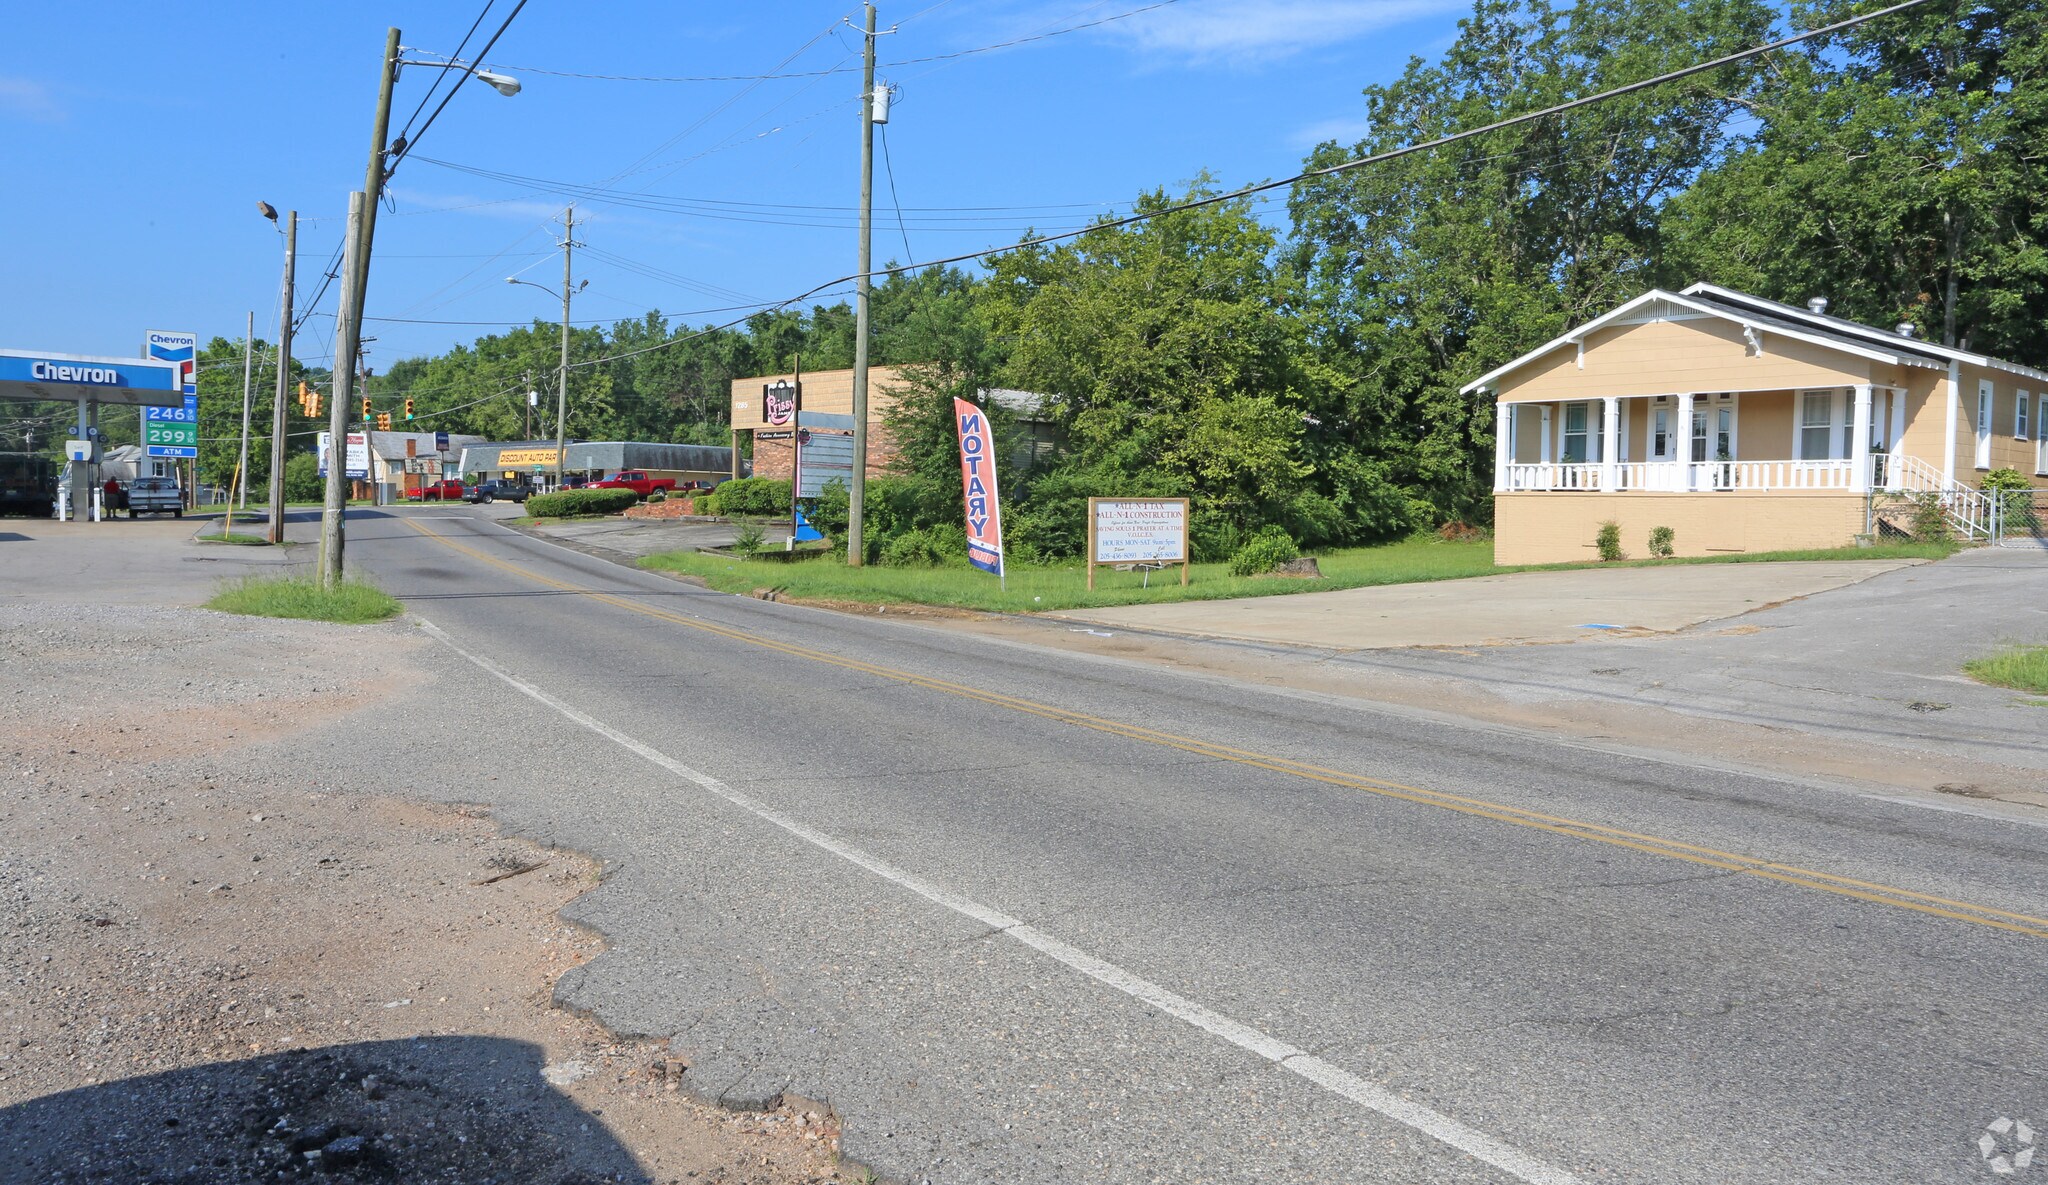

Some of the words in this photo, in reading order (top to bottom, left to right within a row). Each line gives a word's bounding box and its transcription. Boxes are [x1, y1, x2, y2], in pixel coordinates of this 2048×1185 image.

[150, 334, 194, 345] Chevron
[32, 361, 117, 384] Chevron
[149, 407, 185, 420] 246
[149, 430, 185, 442] 299
[500, 453, 528, 463] DISCOUNT
[528, 453, 544, 462] AUTO
[1150, 502, 1164, 510] TAX
[1129, 511, 1183, 519] CONSTRUCTION
